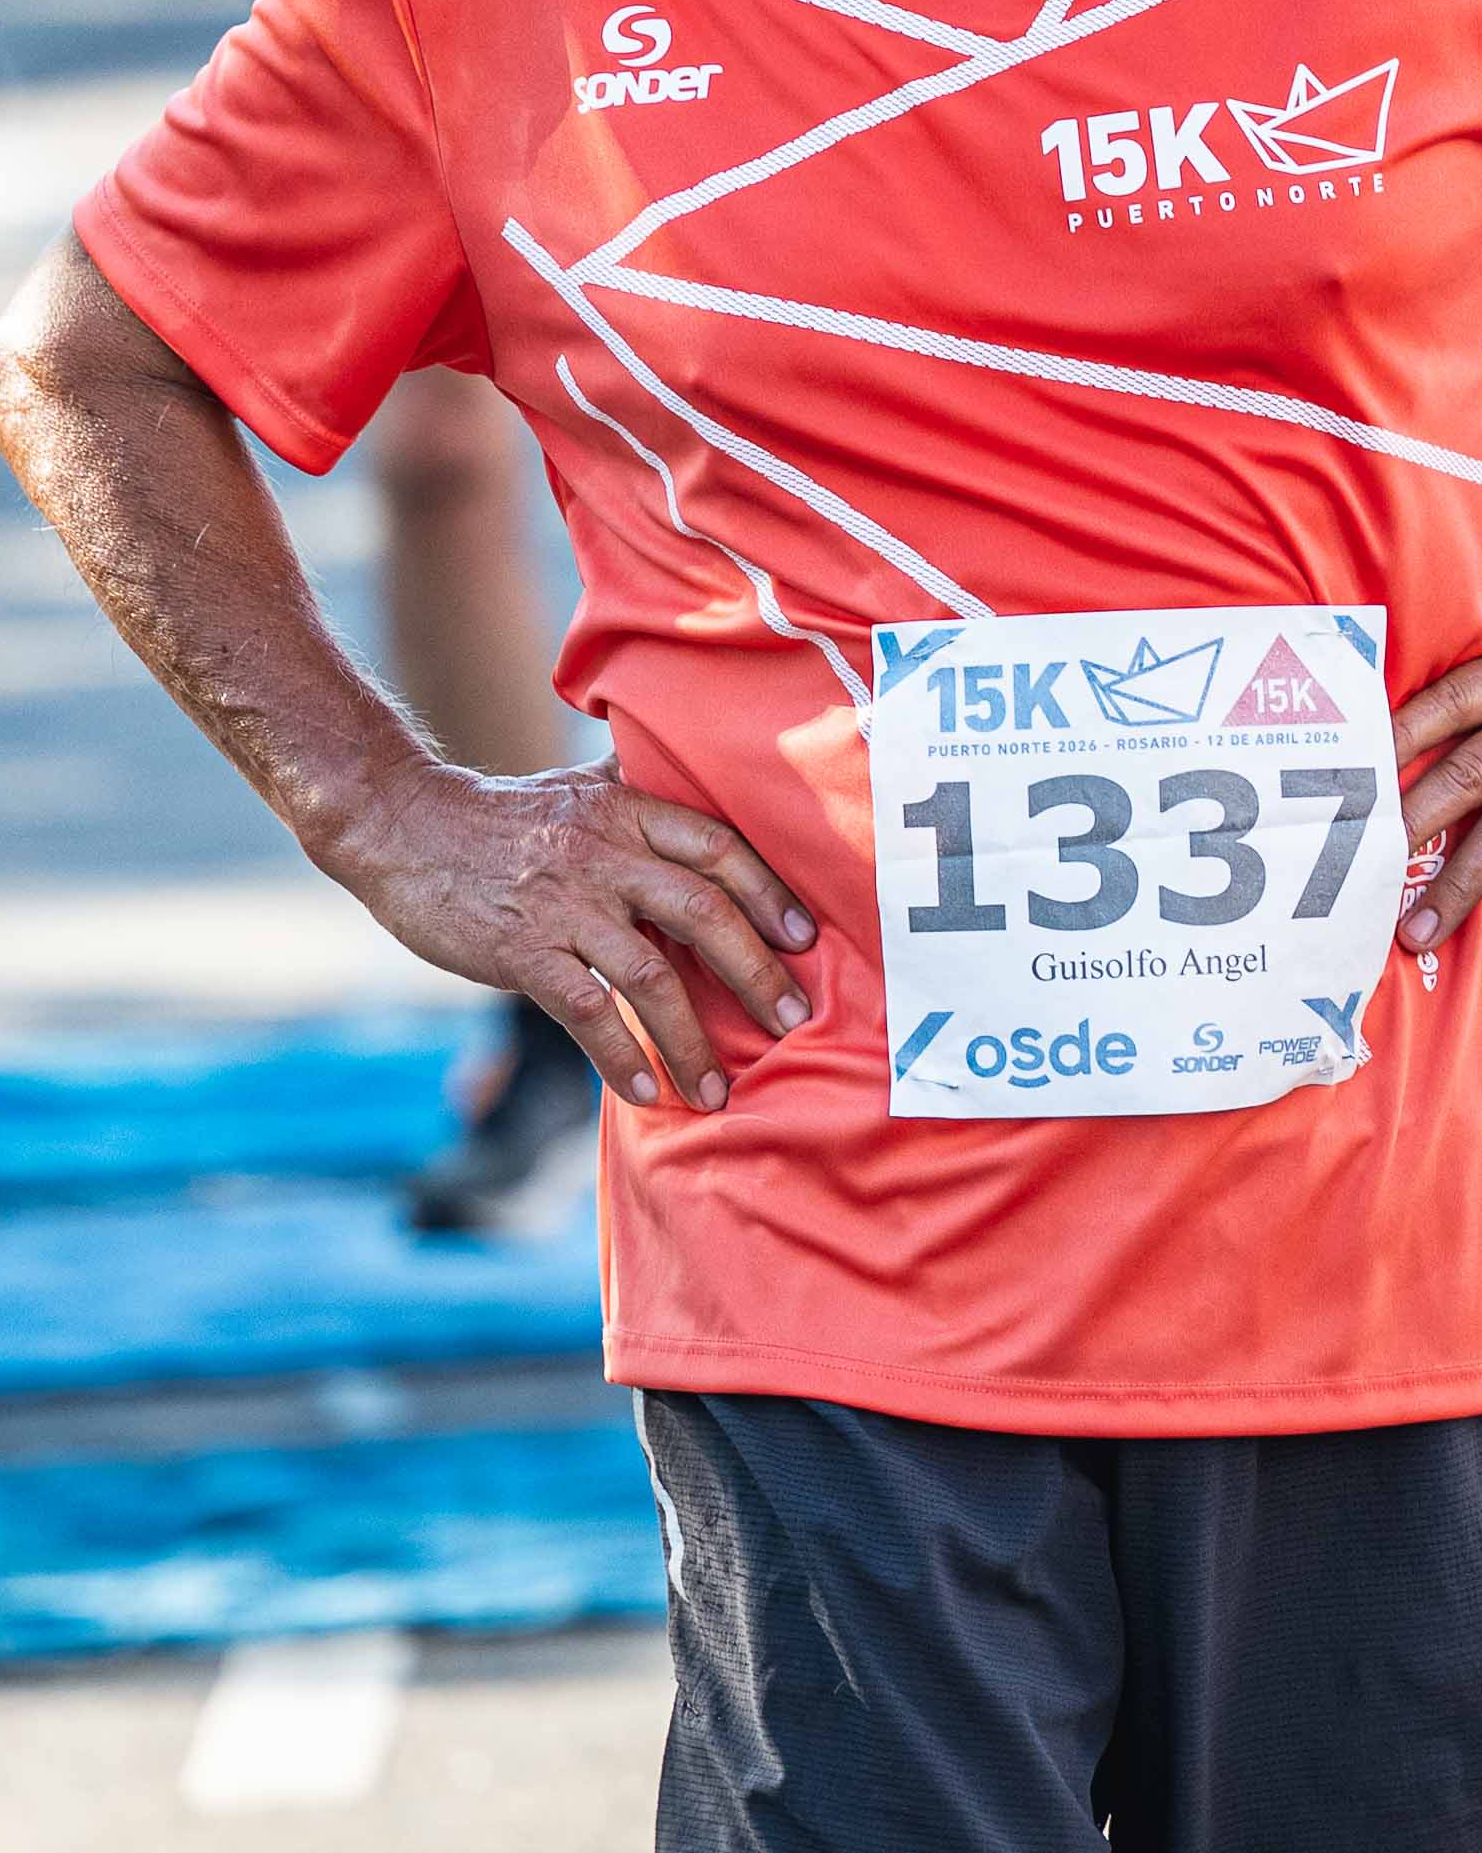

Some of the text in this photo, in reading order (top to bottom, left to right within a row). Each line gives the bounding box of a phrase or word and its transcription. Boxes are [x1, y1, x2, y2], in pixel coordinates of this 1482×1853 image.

[1040, 102, 1231, 202] 15K
[1068, 173, 1384, 234] PUERTO NORTE
[927, 661, 1070, 733] 15K
[1252, 677, 1321, 716] 15K
[927, 744, 992, 757] PUERTO
[998, 741, 1051, 755] NORTE
[1058, 739, 1098, 753] 2026
[1116, 736, 1189, 750] ROSARIO
[1207, 734, 1224, 747] 12
[1230, 733, 1250, 746] DE
[1255, 731, 1299, 745] ABRIL
[1304, 730, 1341, 744] 2026
[902, 767, 1378, 933] 1337
[1031, 945, 1269, 982] Guisolfo Angel
[965, 1018, 1138, 1078] osde
[1259, 1036, 1322, 1055] POWER
[1282, 1049, 1317, 1066] ADE
